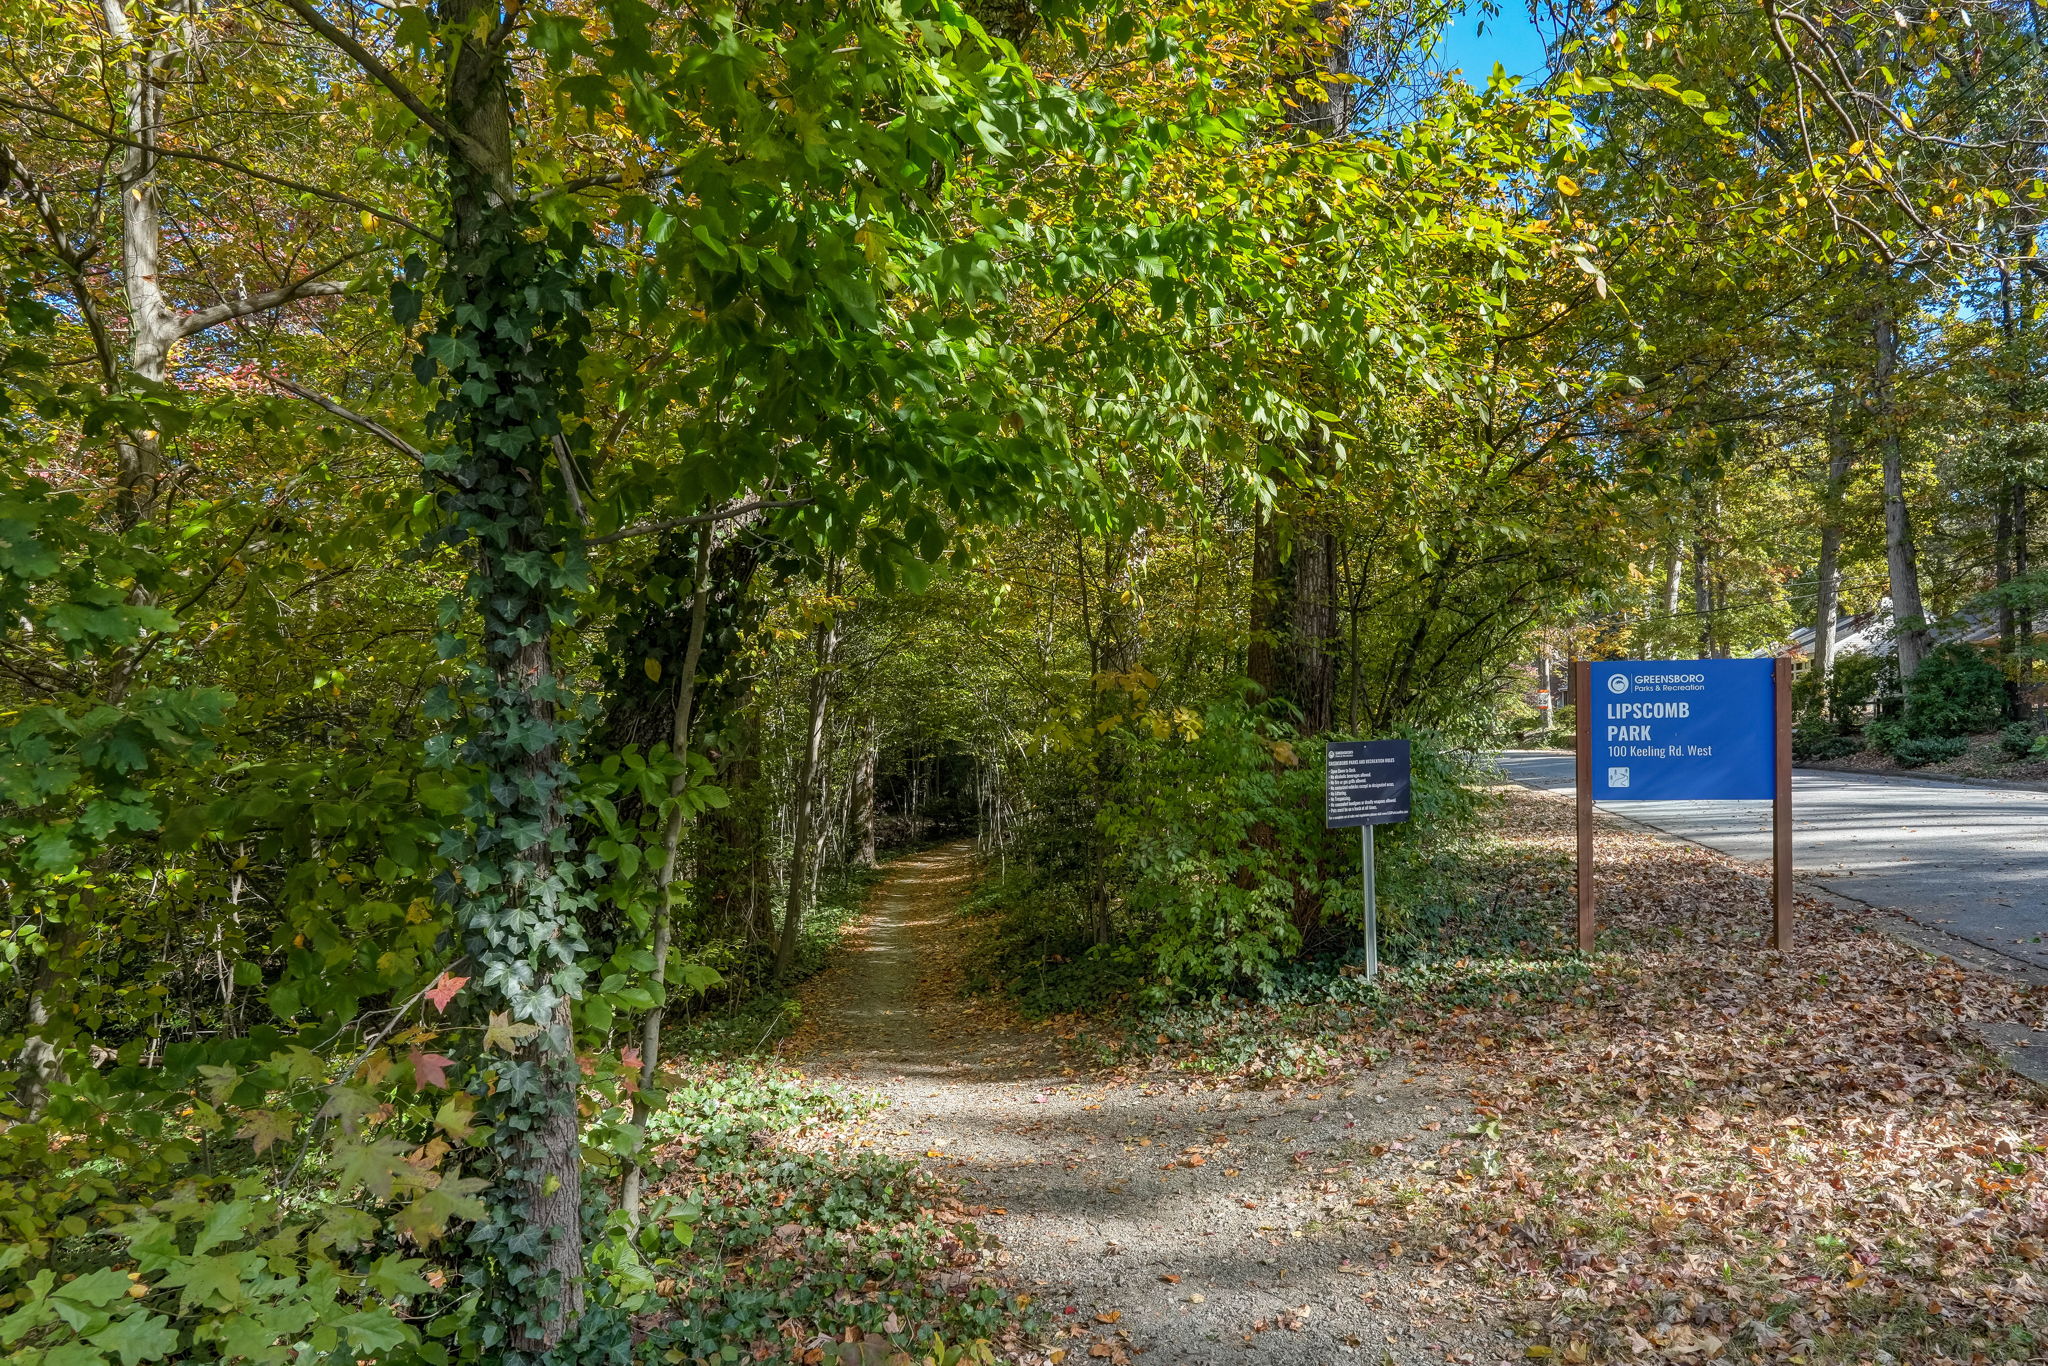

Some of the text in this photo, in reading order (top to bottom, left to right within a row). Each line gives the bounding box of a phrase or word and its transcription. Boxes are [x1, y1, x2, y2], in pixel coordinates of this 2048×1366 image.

[1634, 674, 1705, 684] GREENSBORO
[1607, 702, 1690, 719] LIPSCOMB
[1607, 725, 1652, 741] PARK
[1608, 745, 1712, 759] 100 Keeling Rd. West
